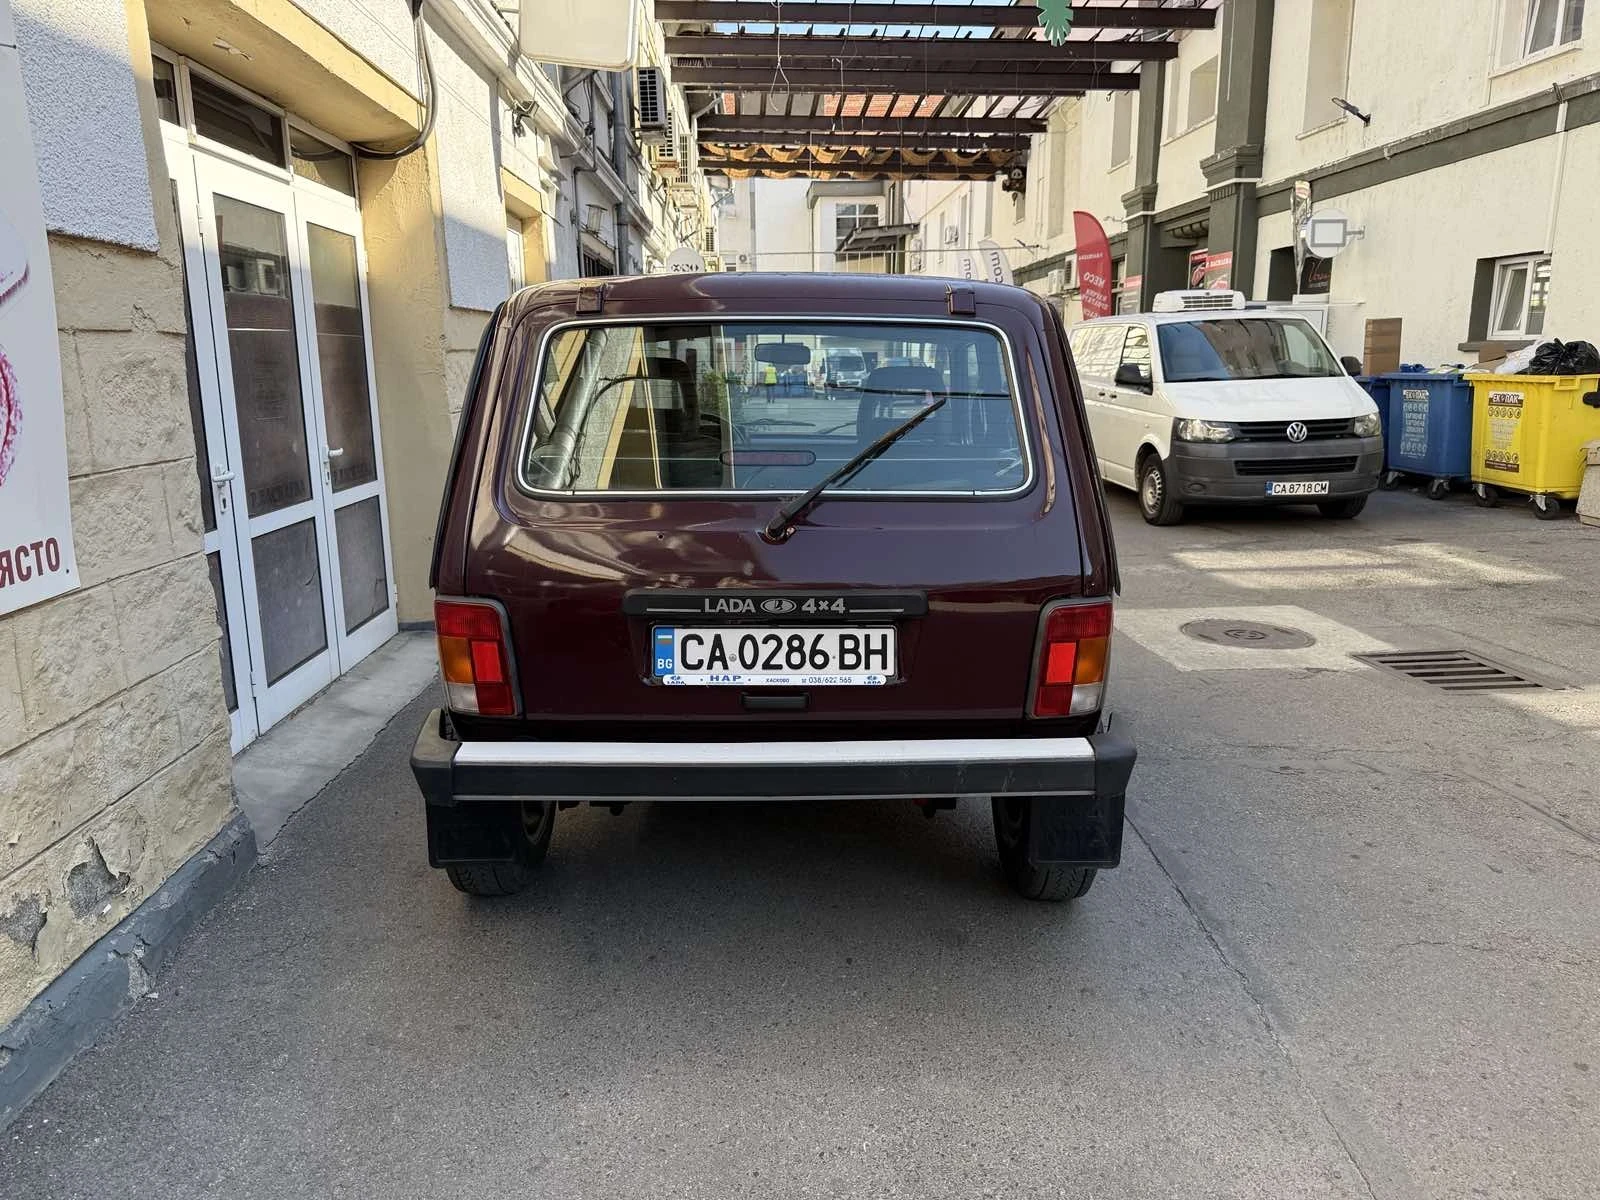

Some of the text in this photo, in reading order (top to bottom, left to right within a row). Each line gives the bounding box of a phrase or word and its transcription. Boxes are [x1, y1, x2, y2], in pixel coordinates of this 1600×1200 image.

[1274, 483, 1327, 493] CA 8718 CM
[704, 598, 756, 613] LADA
[680, 633, 888, 671] CA 0286 BH
[657, 658, 673, 669] BG
